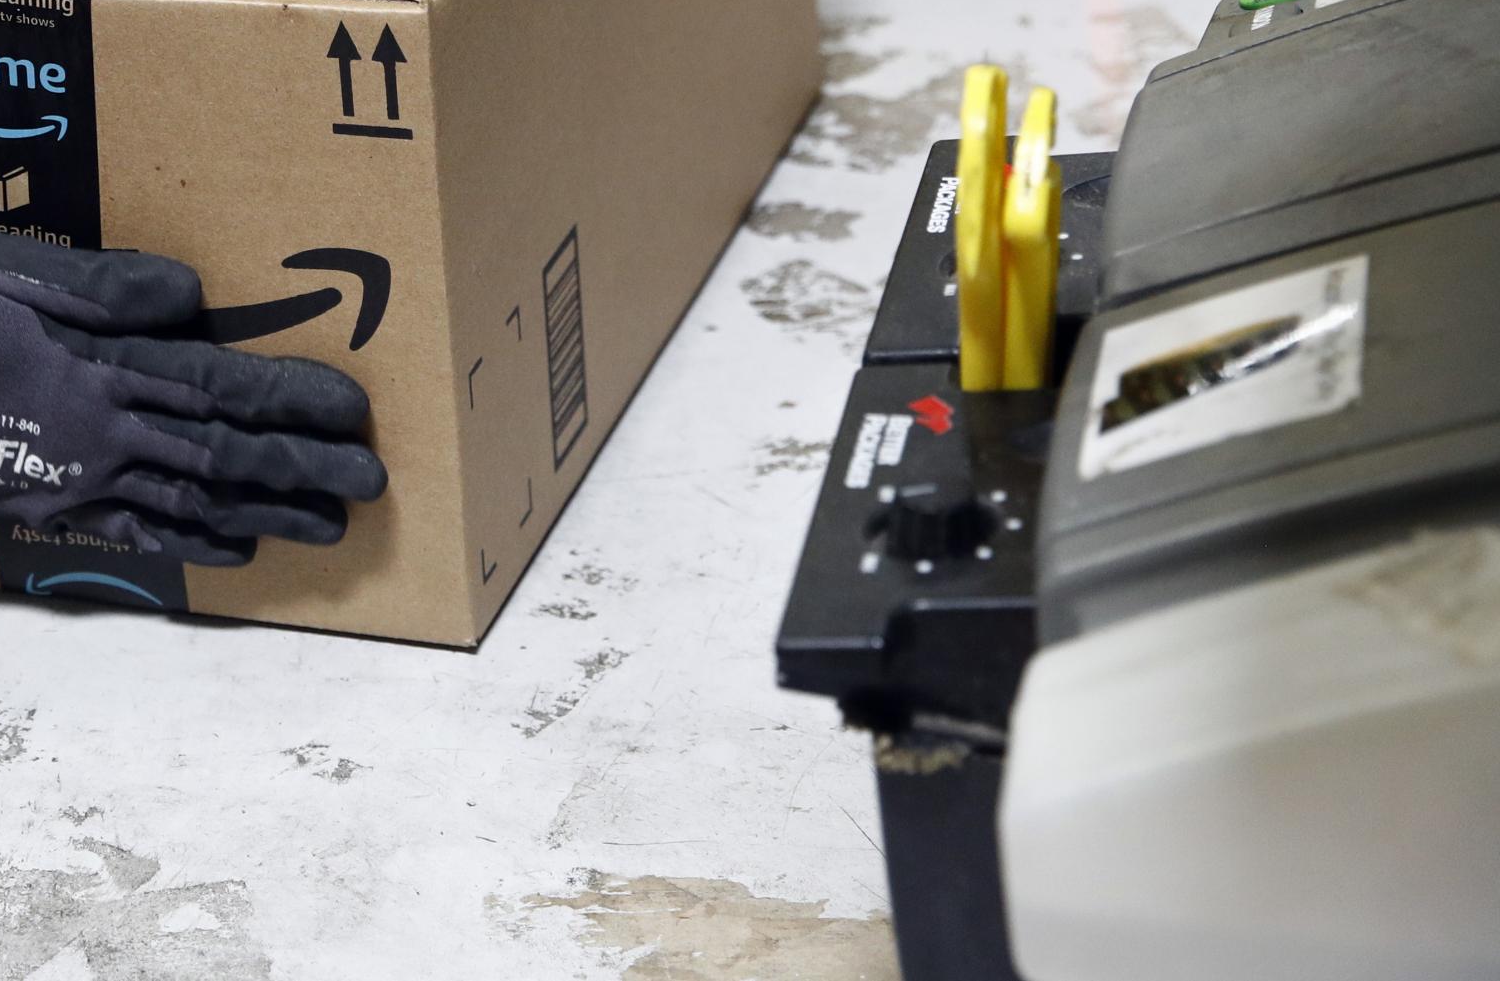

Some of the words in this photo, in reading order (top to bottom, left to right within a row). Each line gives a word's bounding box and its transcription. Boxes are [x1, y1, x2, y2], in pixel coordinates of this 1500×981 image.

[0, 11, 13, 22] tv
[15, 12, 56, 28] shows
[926, 176, 961, 234] PACKAGES
[0, 414, 41, 437] 11-840
